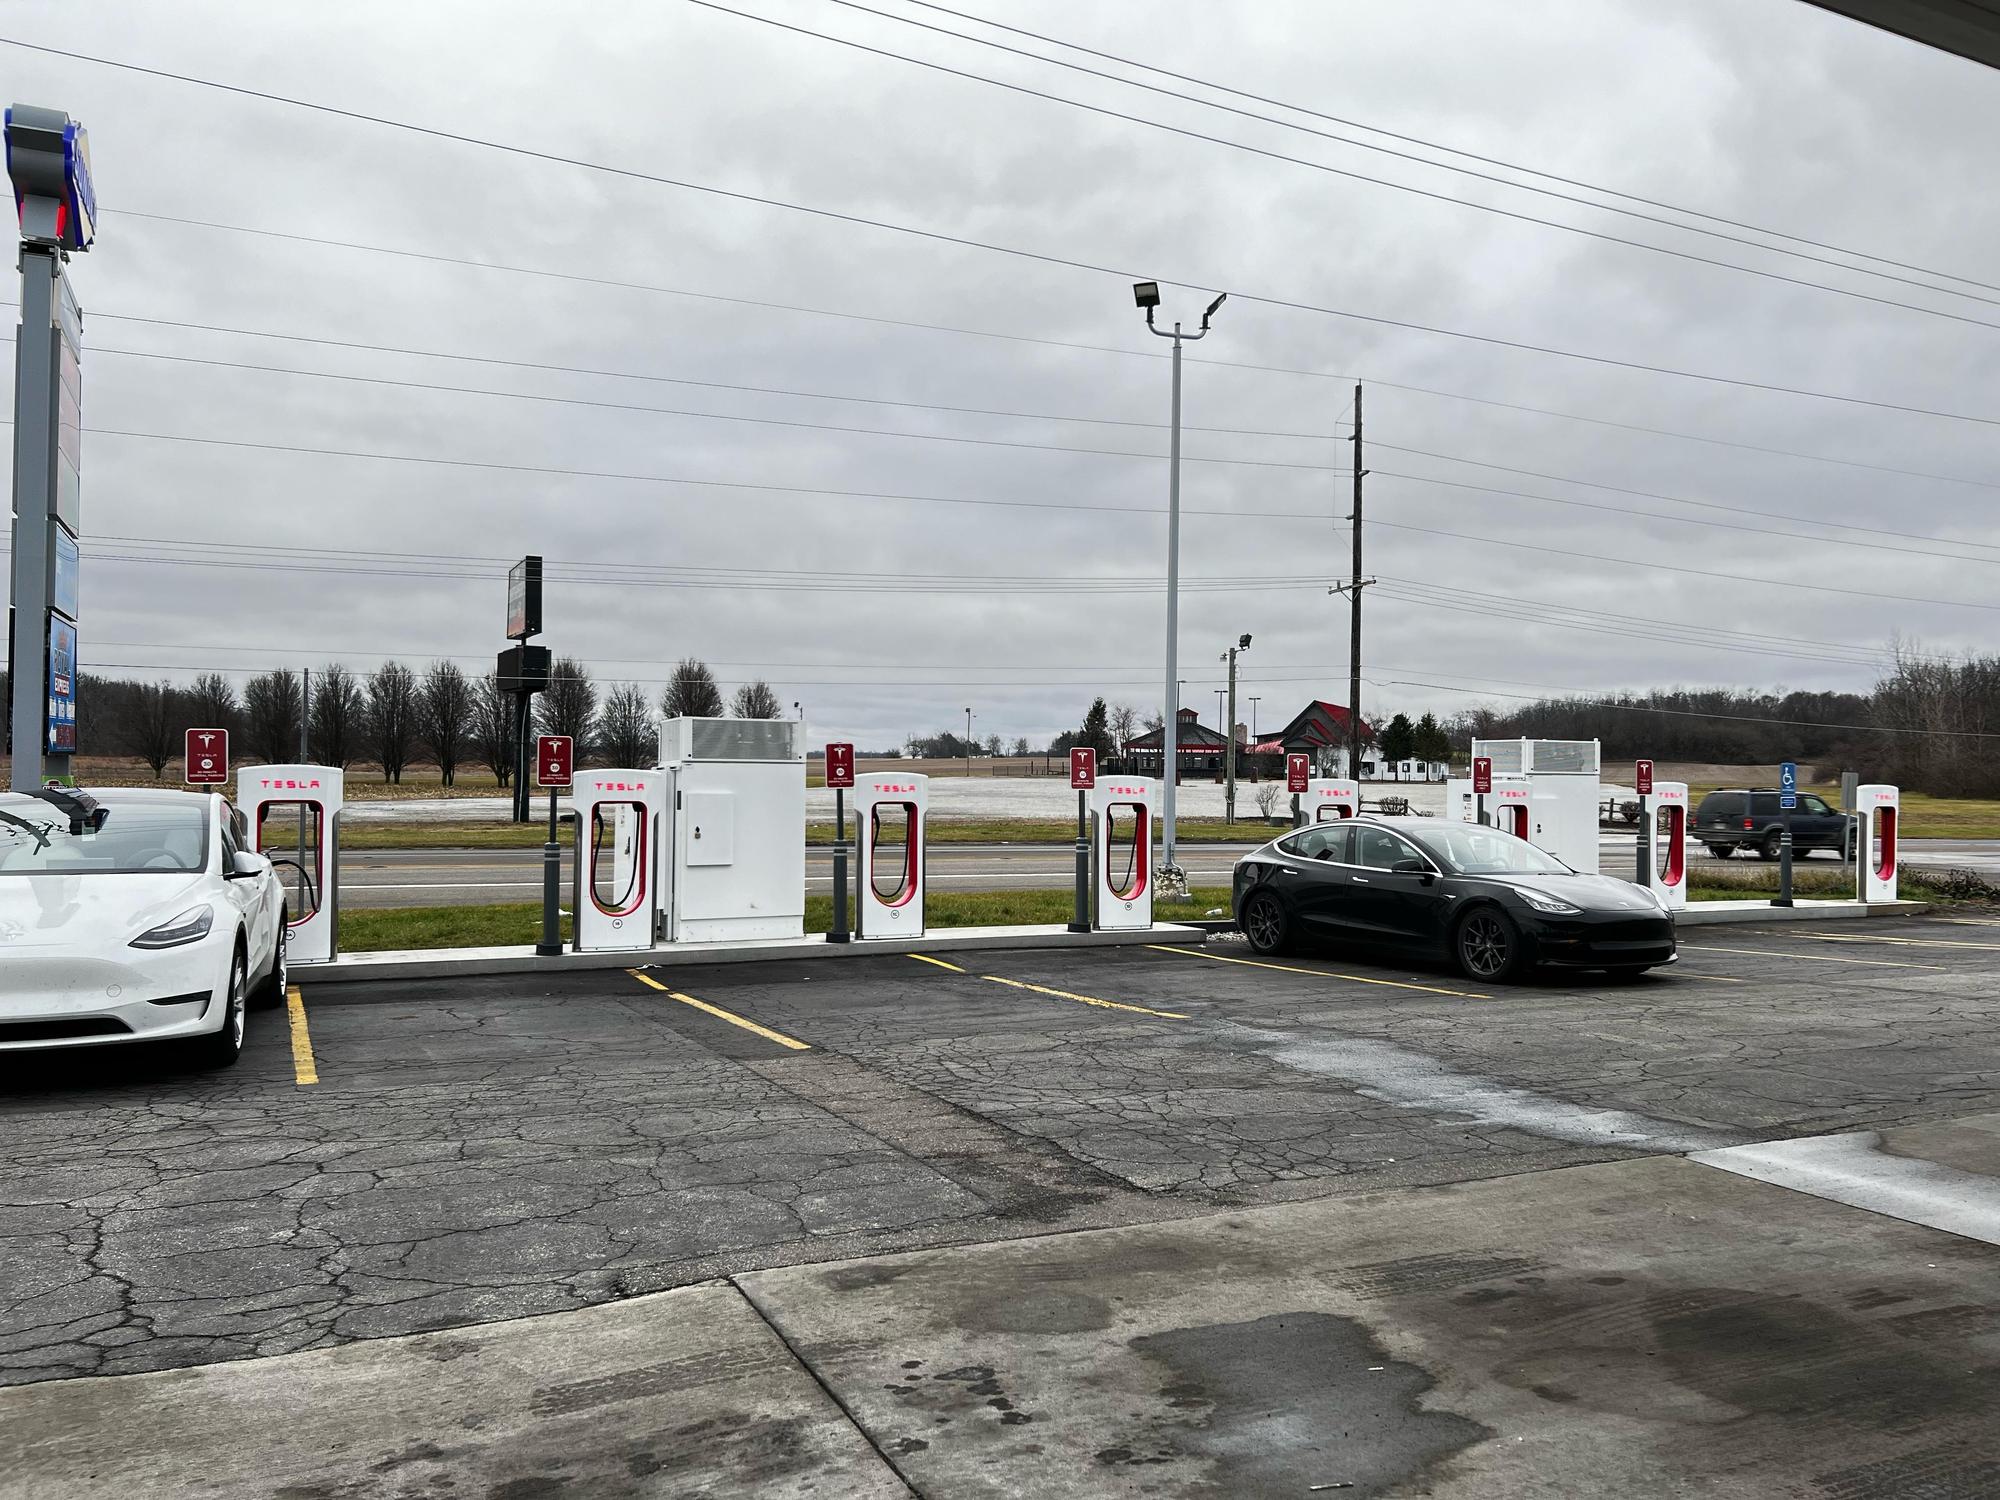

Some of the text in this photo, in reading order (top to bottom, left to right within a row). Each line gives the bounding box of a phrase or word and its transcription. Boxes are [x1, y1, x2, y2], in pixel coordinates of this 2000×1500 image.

[260, 780, 320, 789] TESLA
[594, 783, 645, 791] TESLA
[873, 784, 916, 793] TESLA
[1108, 787, 1145, 795] TESLA
